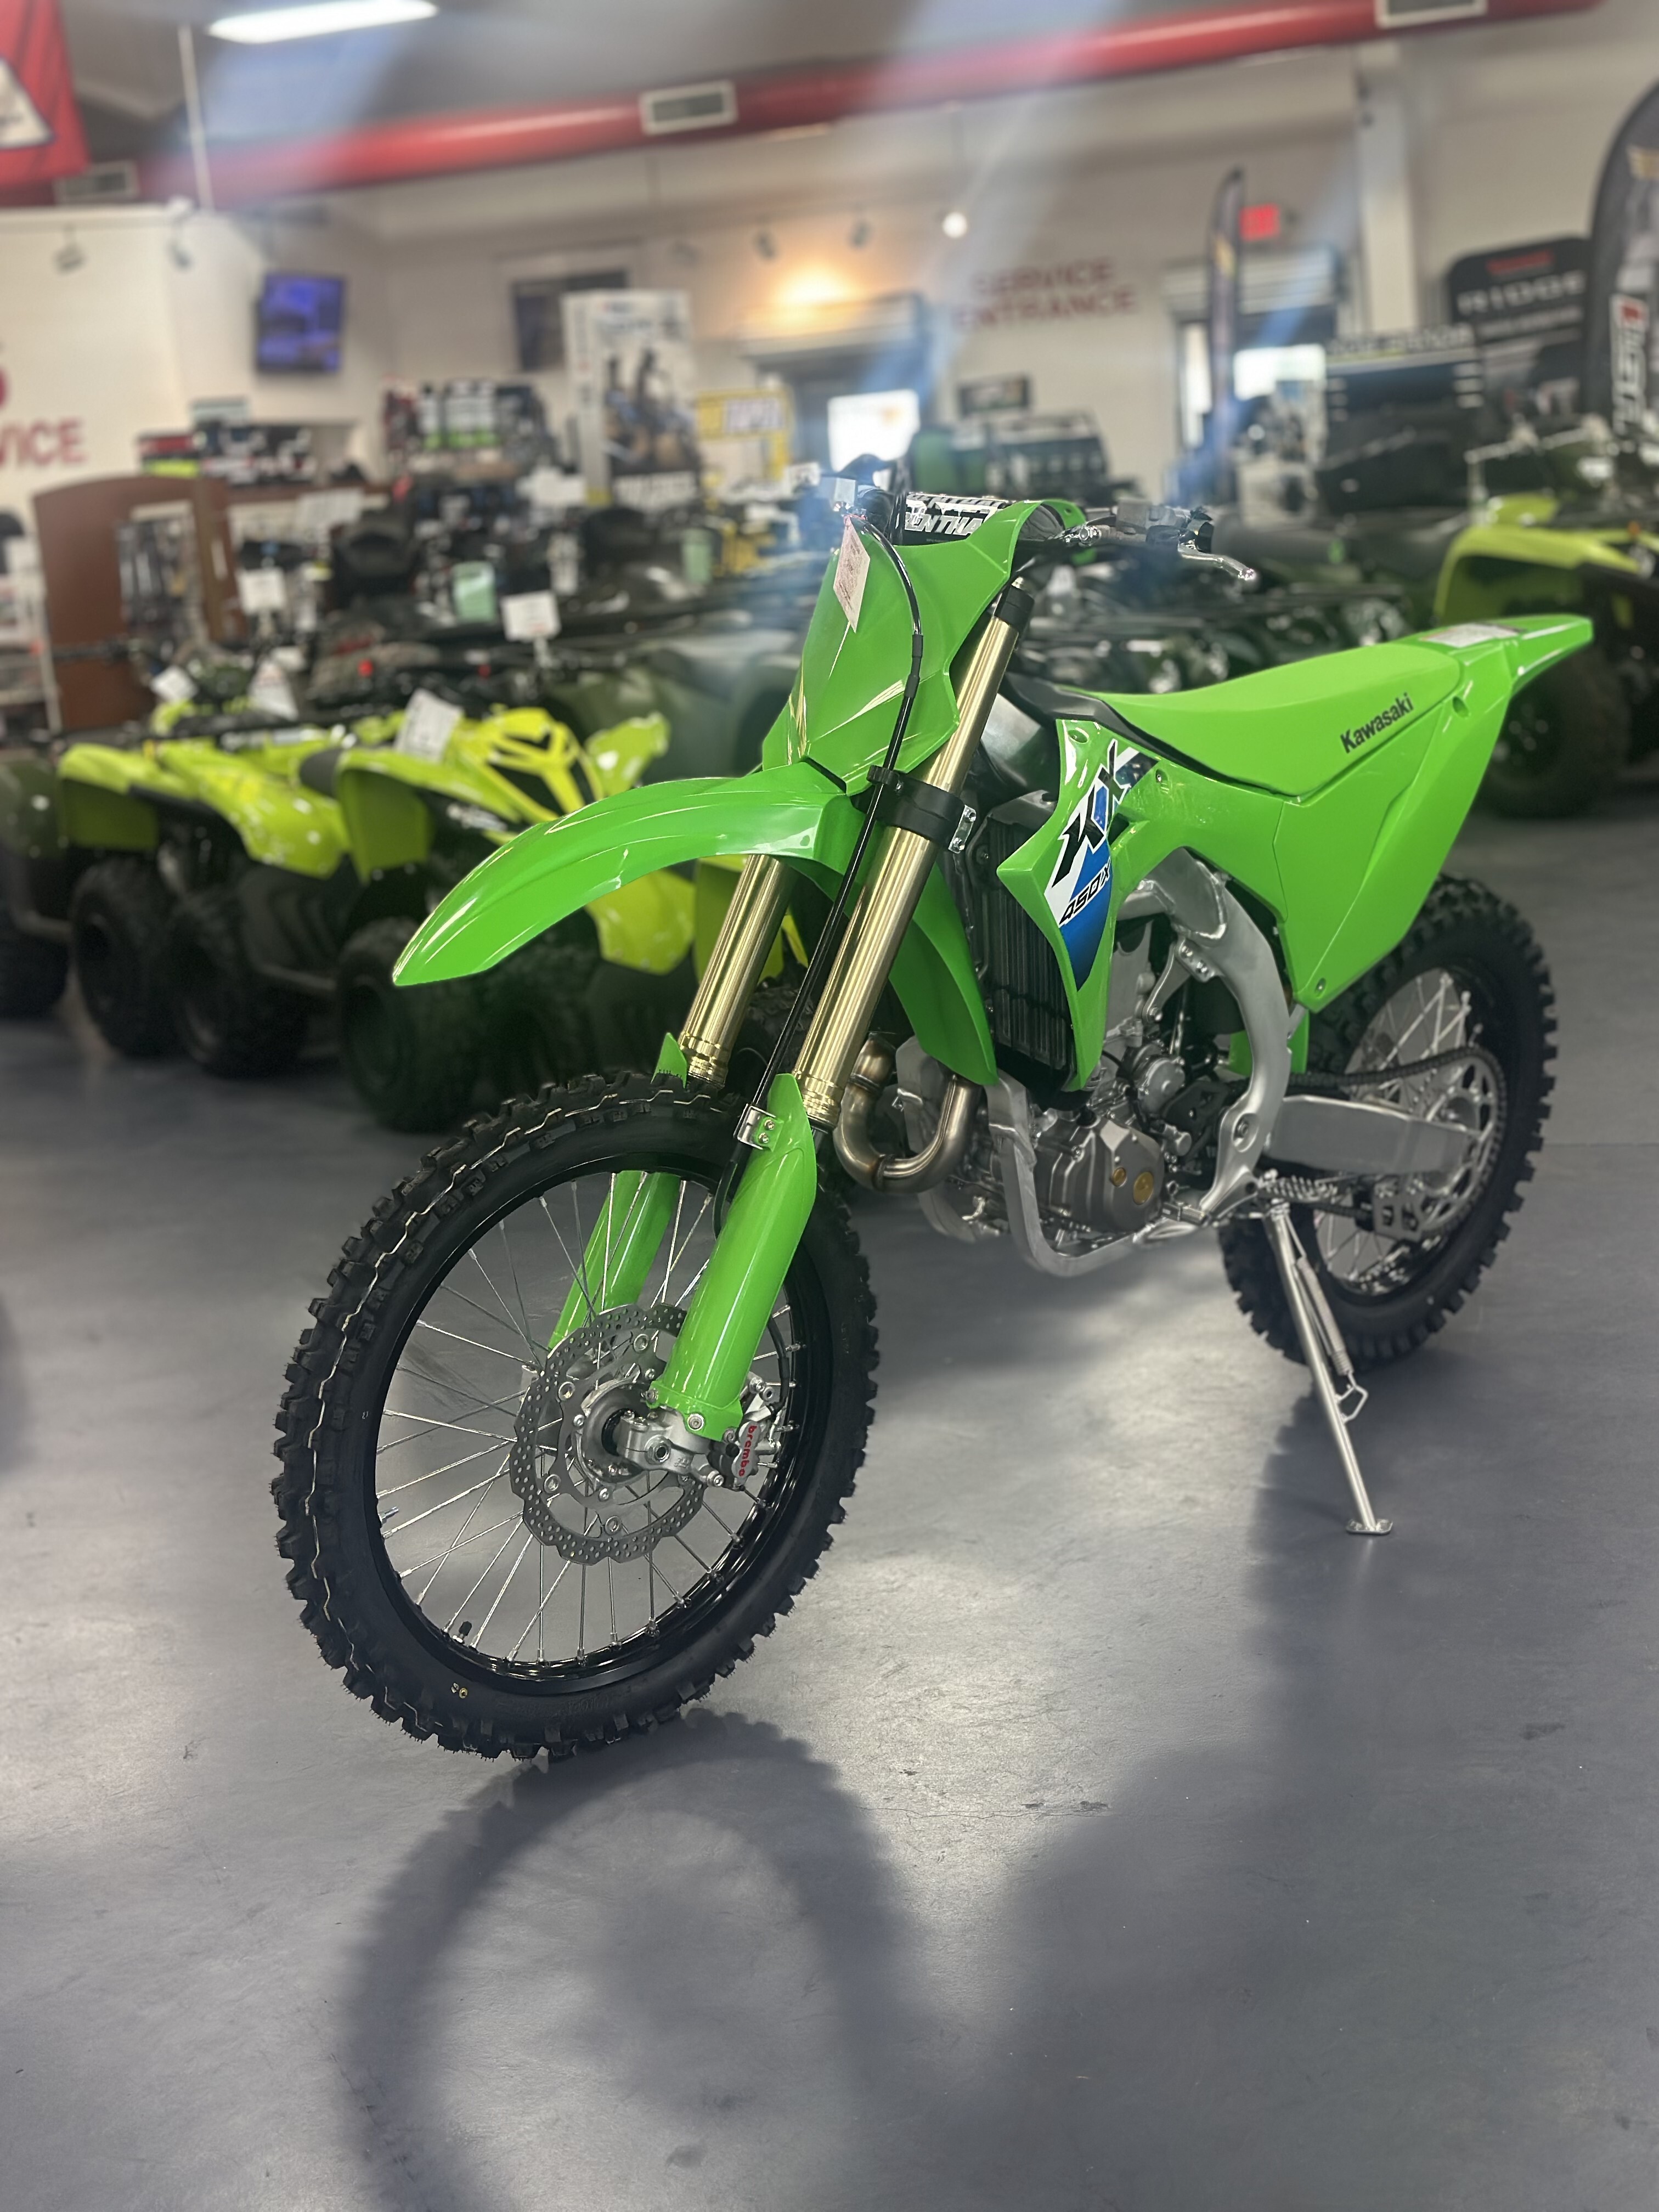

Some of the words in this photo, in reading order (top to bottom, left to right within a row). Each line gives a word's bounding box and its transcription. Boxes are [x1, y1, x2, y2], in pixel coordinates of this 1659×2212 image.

[1340, 692, 1414, 754] Kawasaki
[1058, 857, 1111, 927] 450X
[738, 1425, 758, 1477] brembo
